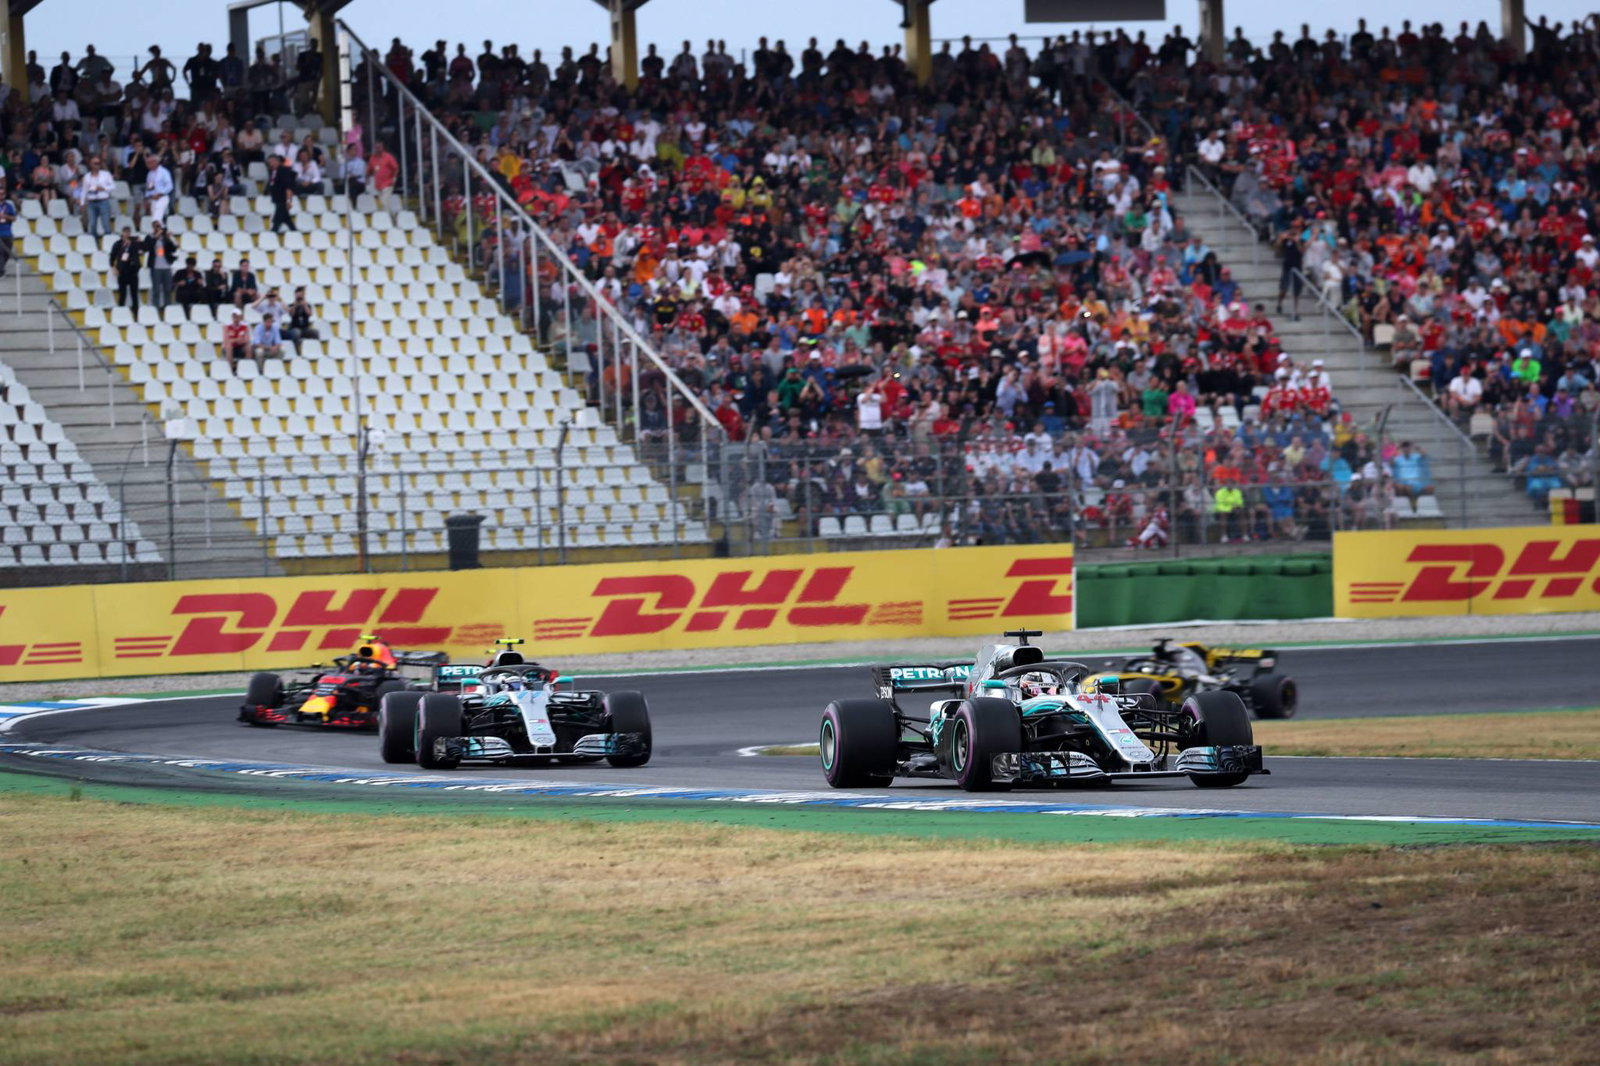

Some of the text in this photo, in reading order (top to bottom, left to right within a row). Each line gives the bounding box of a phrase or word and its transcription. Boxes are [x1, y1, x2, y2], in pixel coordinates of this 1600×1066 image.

[1402, 539, 1600, 601] DH
[590, 567, 870, 637] DHL
[169, 588, 452, 656] DHL
[441, 665, 483, 676] PETR
[890, 665, 971, 679] PETRN
[1077, 694, 1110, 703] 44
